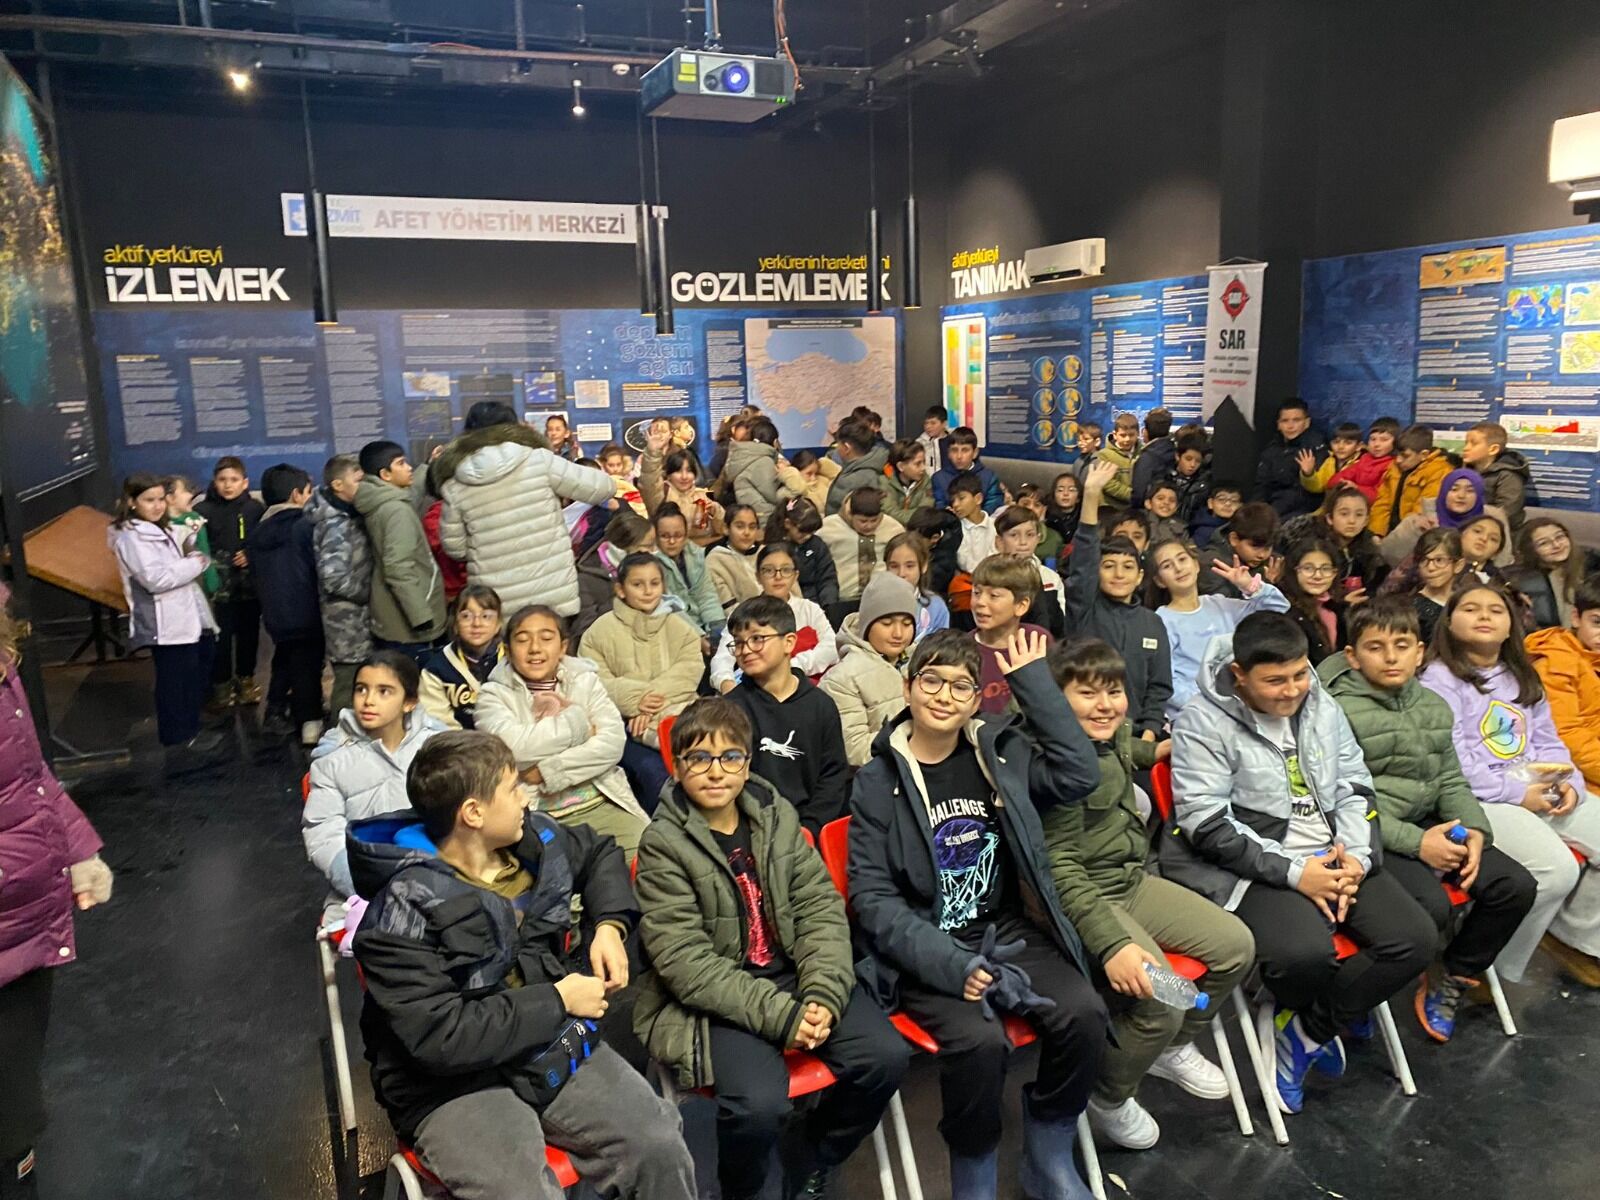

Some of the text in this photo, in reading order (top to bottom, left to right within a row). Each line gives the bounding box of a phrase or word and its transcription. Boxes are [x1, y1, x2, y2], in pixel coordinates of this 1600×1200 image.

[327, 206, 361, 223] ZMİT
[373, 208, 431, 230] AFET
[436, 207, 532, 232] YÖNETİM
[538, 213, 626, 235] MERKEZİ
[820, 254, 891, 270] hareketlni
[951, 259, 1031, 299] TANIMAK
[615, 321, 693, 343] depm
[1219, 329, 1246, 350] SAR
[930, 798, 989, 829] HALLENGE
